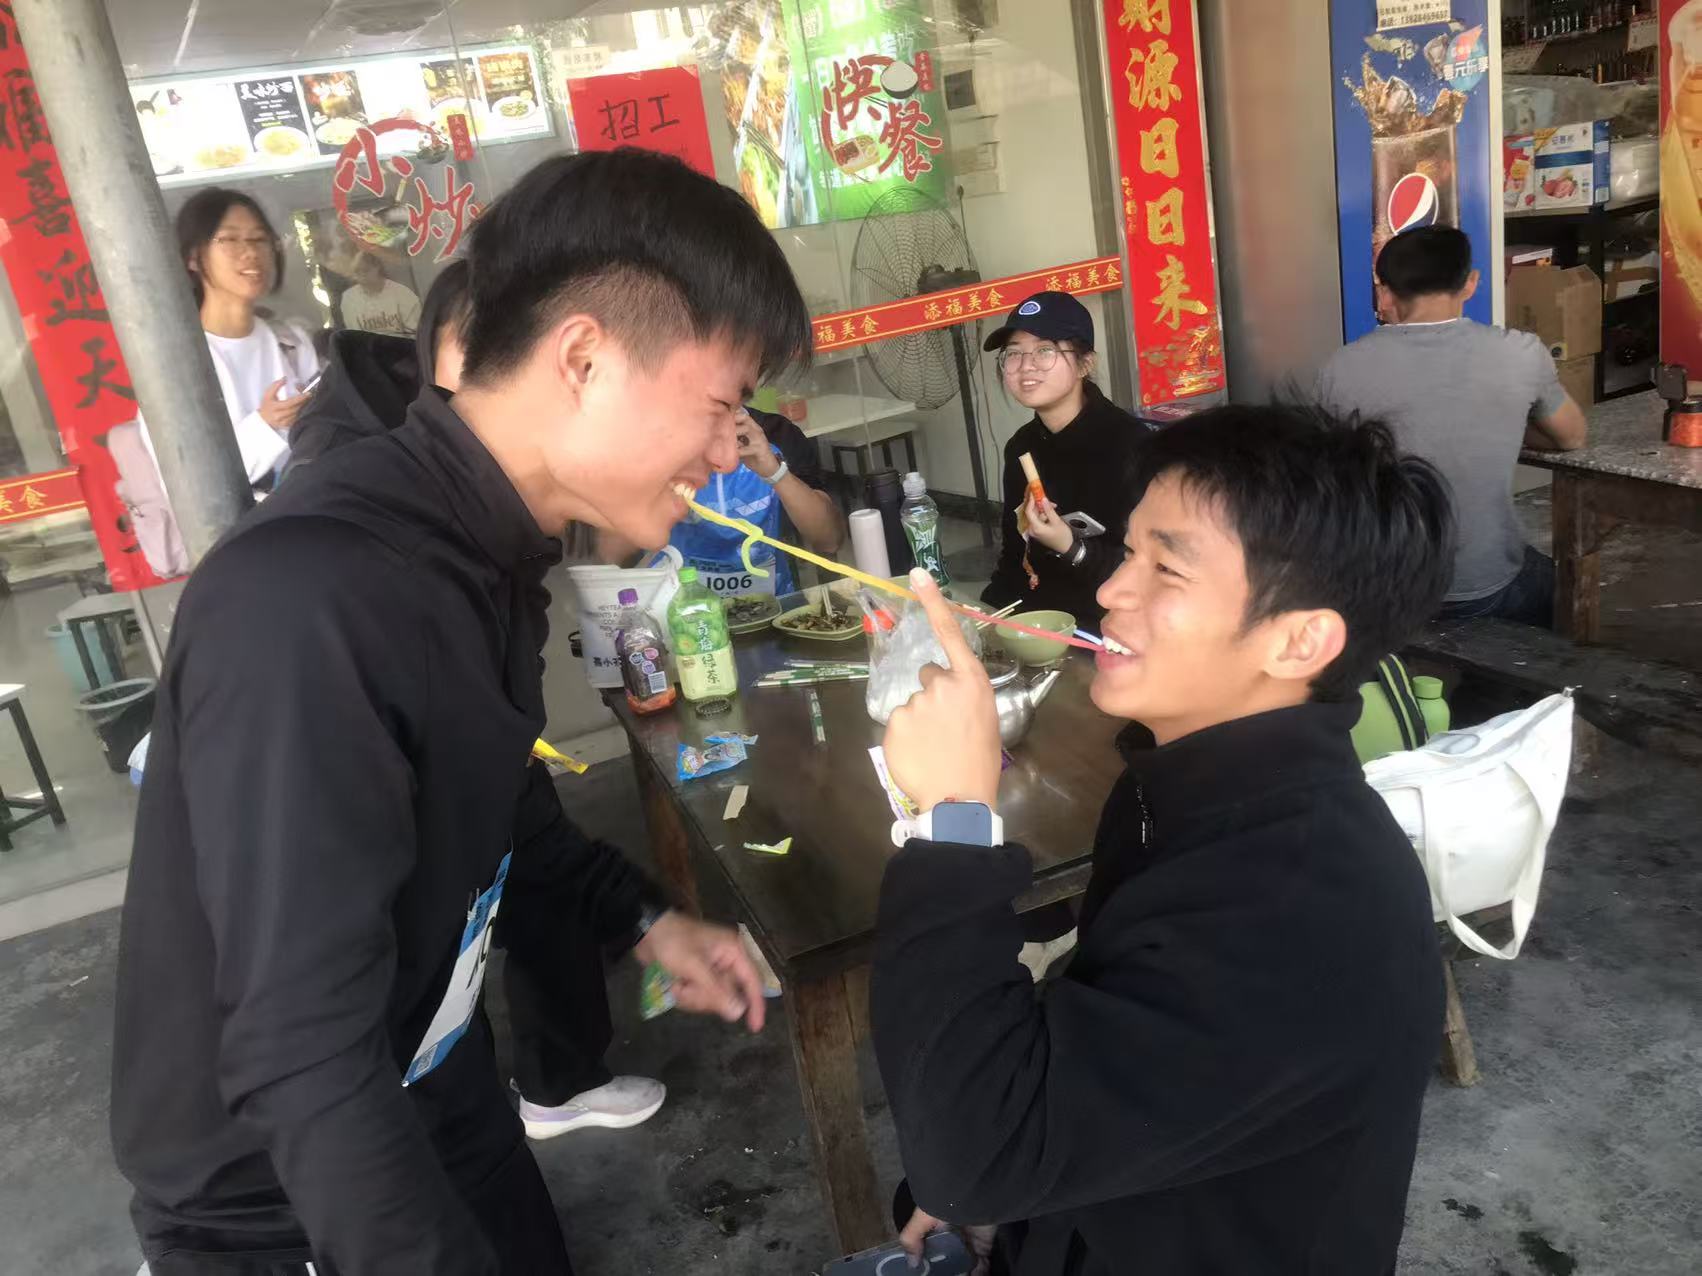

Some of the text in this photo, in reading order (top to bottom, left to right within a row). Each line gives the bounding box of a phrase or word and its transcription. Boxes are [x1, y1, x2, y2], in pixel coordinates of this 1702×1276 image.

[598, 94, 680, 141] 招工
[335, 127, 481, 264] 小炒
[1045, 263, 1120, 291] 添福美食
[924, 288, 1004, 321] 添福美食
[817, 315, 879, 344] 福美食
[706, 575, 752, 591] 1006
